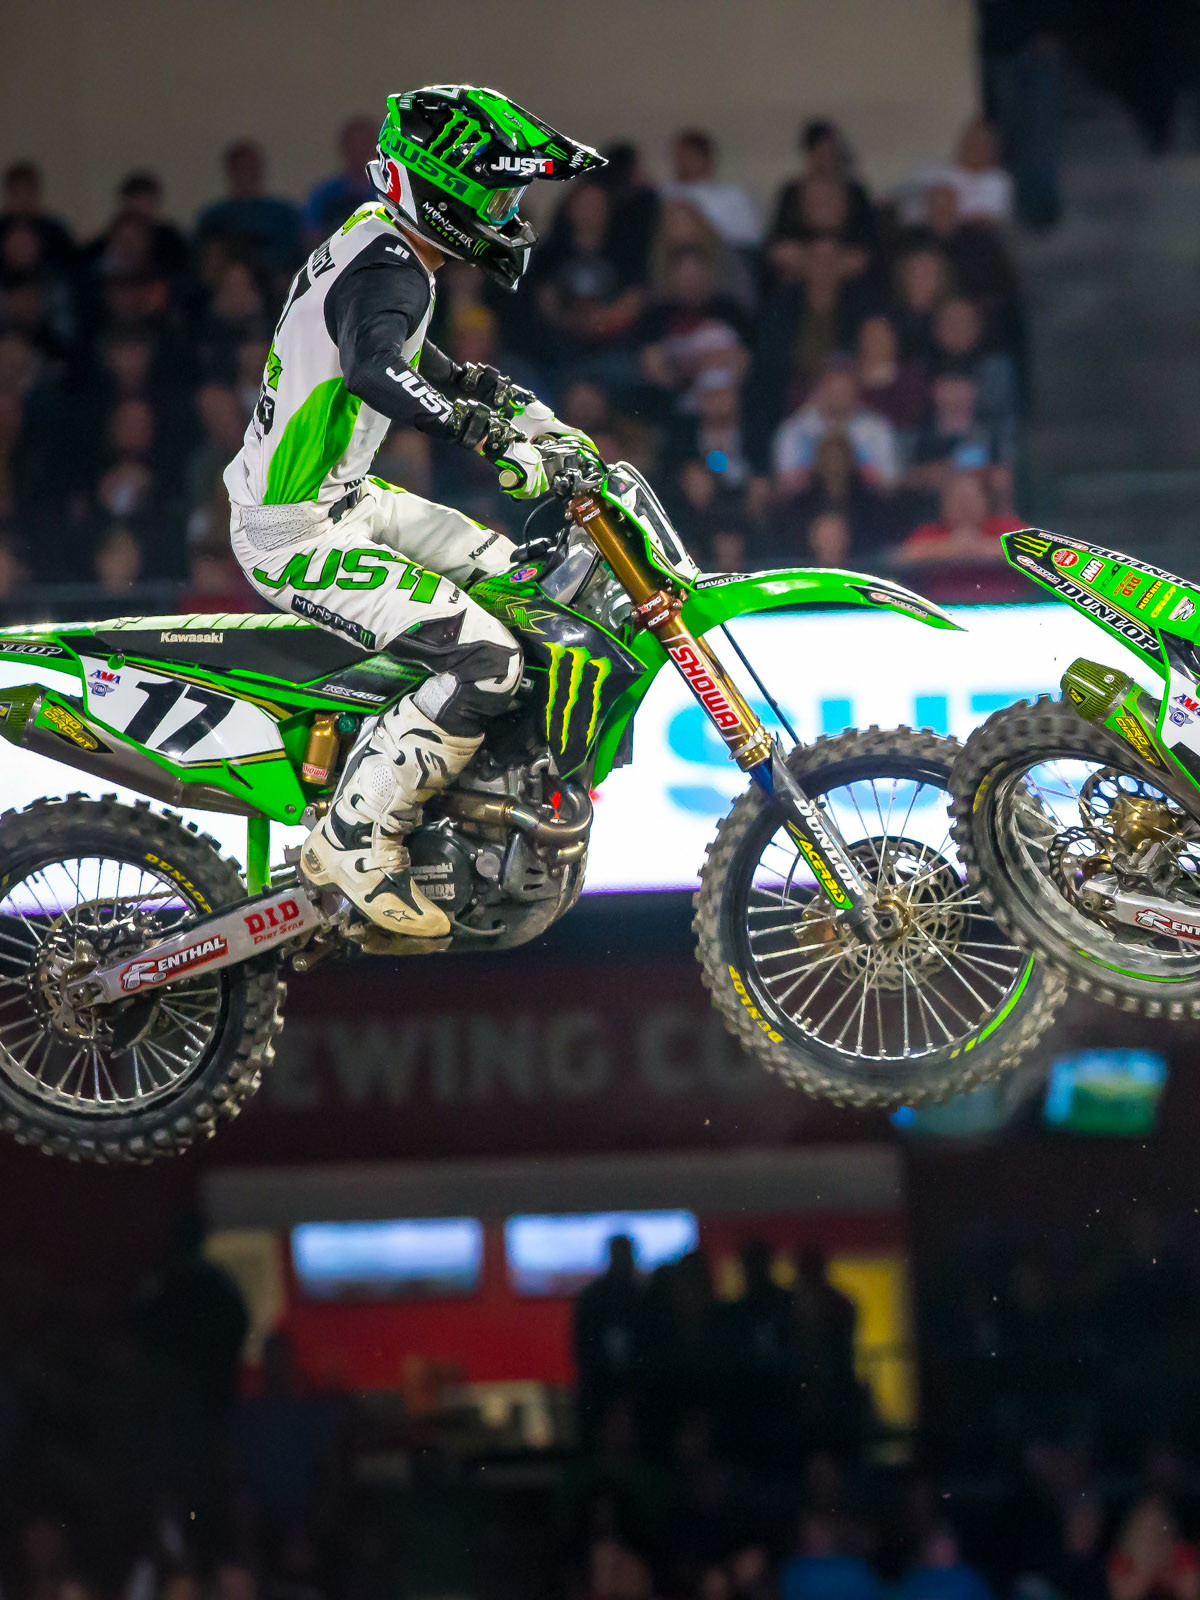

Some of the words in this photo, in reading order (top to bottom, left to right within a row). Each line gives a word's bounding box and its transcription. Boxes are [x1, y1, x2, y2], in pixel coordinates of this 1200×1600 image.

[491, 156, 553, 175] JUST1
[252, 548, 442, 604] JUST1
[160, 631, 224, 644] Kawasaki
[1055, 581, 1161, 652] DUNLOP
[89, 669, 121, 685] AMA
[668, 645, 742, 730] SHOWA
[41, 709, 95, 750] CIRCUIT
[122, 680, 237, 757] 17
[1113, 716, 1156, 766] CIRCUIT
[1124, 716, 1149, 746] PRO
[793, 798, 861, 897] DUNLOP
[799, 838, 846, 904] ACERBIS
[145, 852, 213, 914] DUNLOP
[728, 963, 783, 1043] DUNLOP
